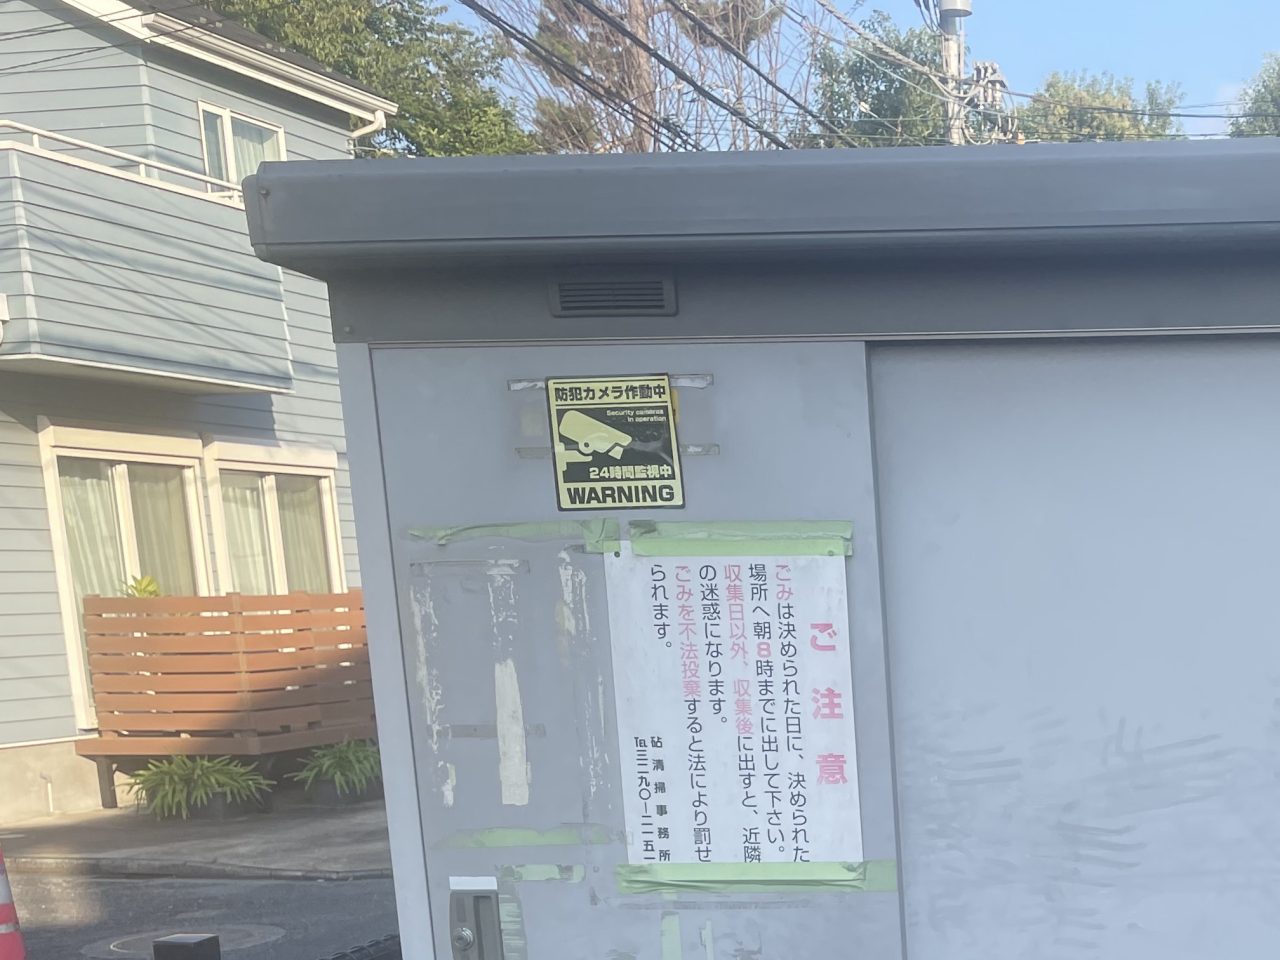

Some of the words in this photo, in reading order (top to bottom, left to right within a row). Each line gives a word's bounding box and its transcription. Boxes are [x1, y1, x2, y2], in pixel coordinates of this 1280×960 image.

[554, 384, 666, 402] 防犯カメラ作動中
[606, 409, 634, 417] Security
[635, 415, 667, 423] operation
[589, 464, 672, 479] 24時間監視中
[566, 484, 675, 505] WARNING
[650, 563, 672, 648] られます。
[698, 564, 728, 724] の迷惑になります。
[774, 563, 810, 862] ごみは決められた日に、決められた
